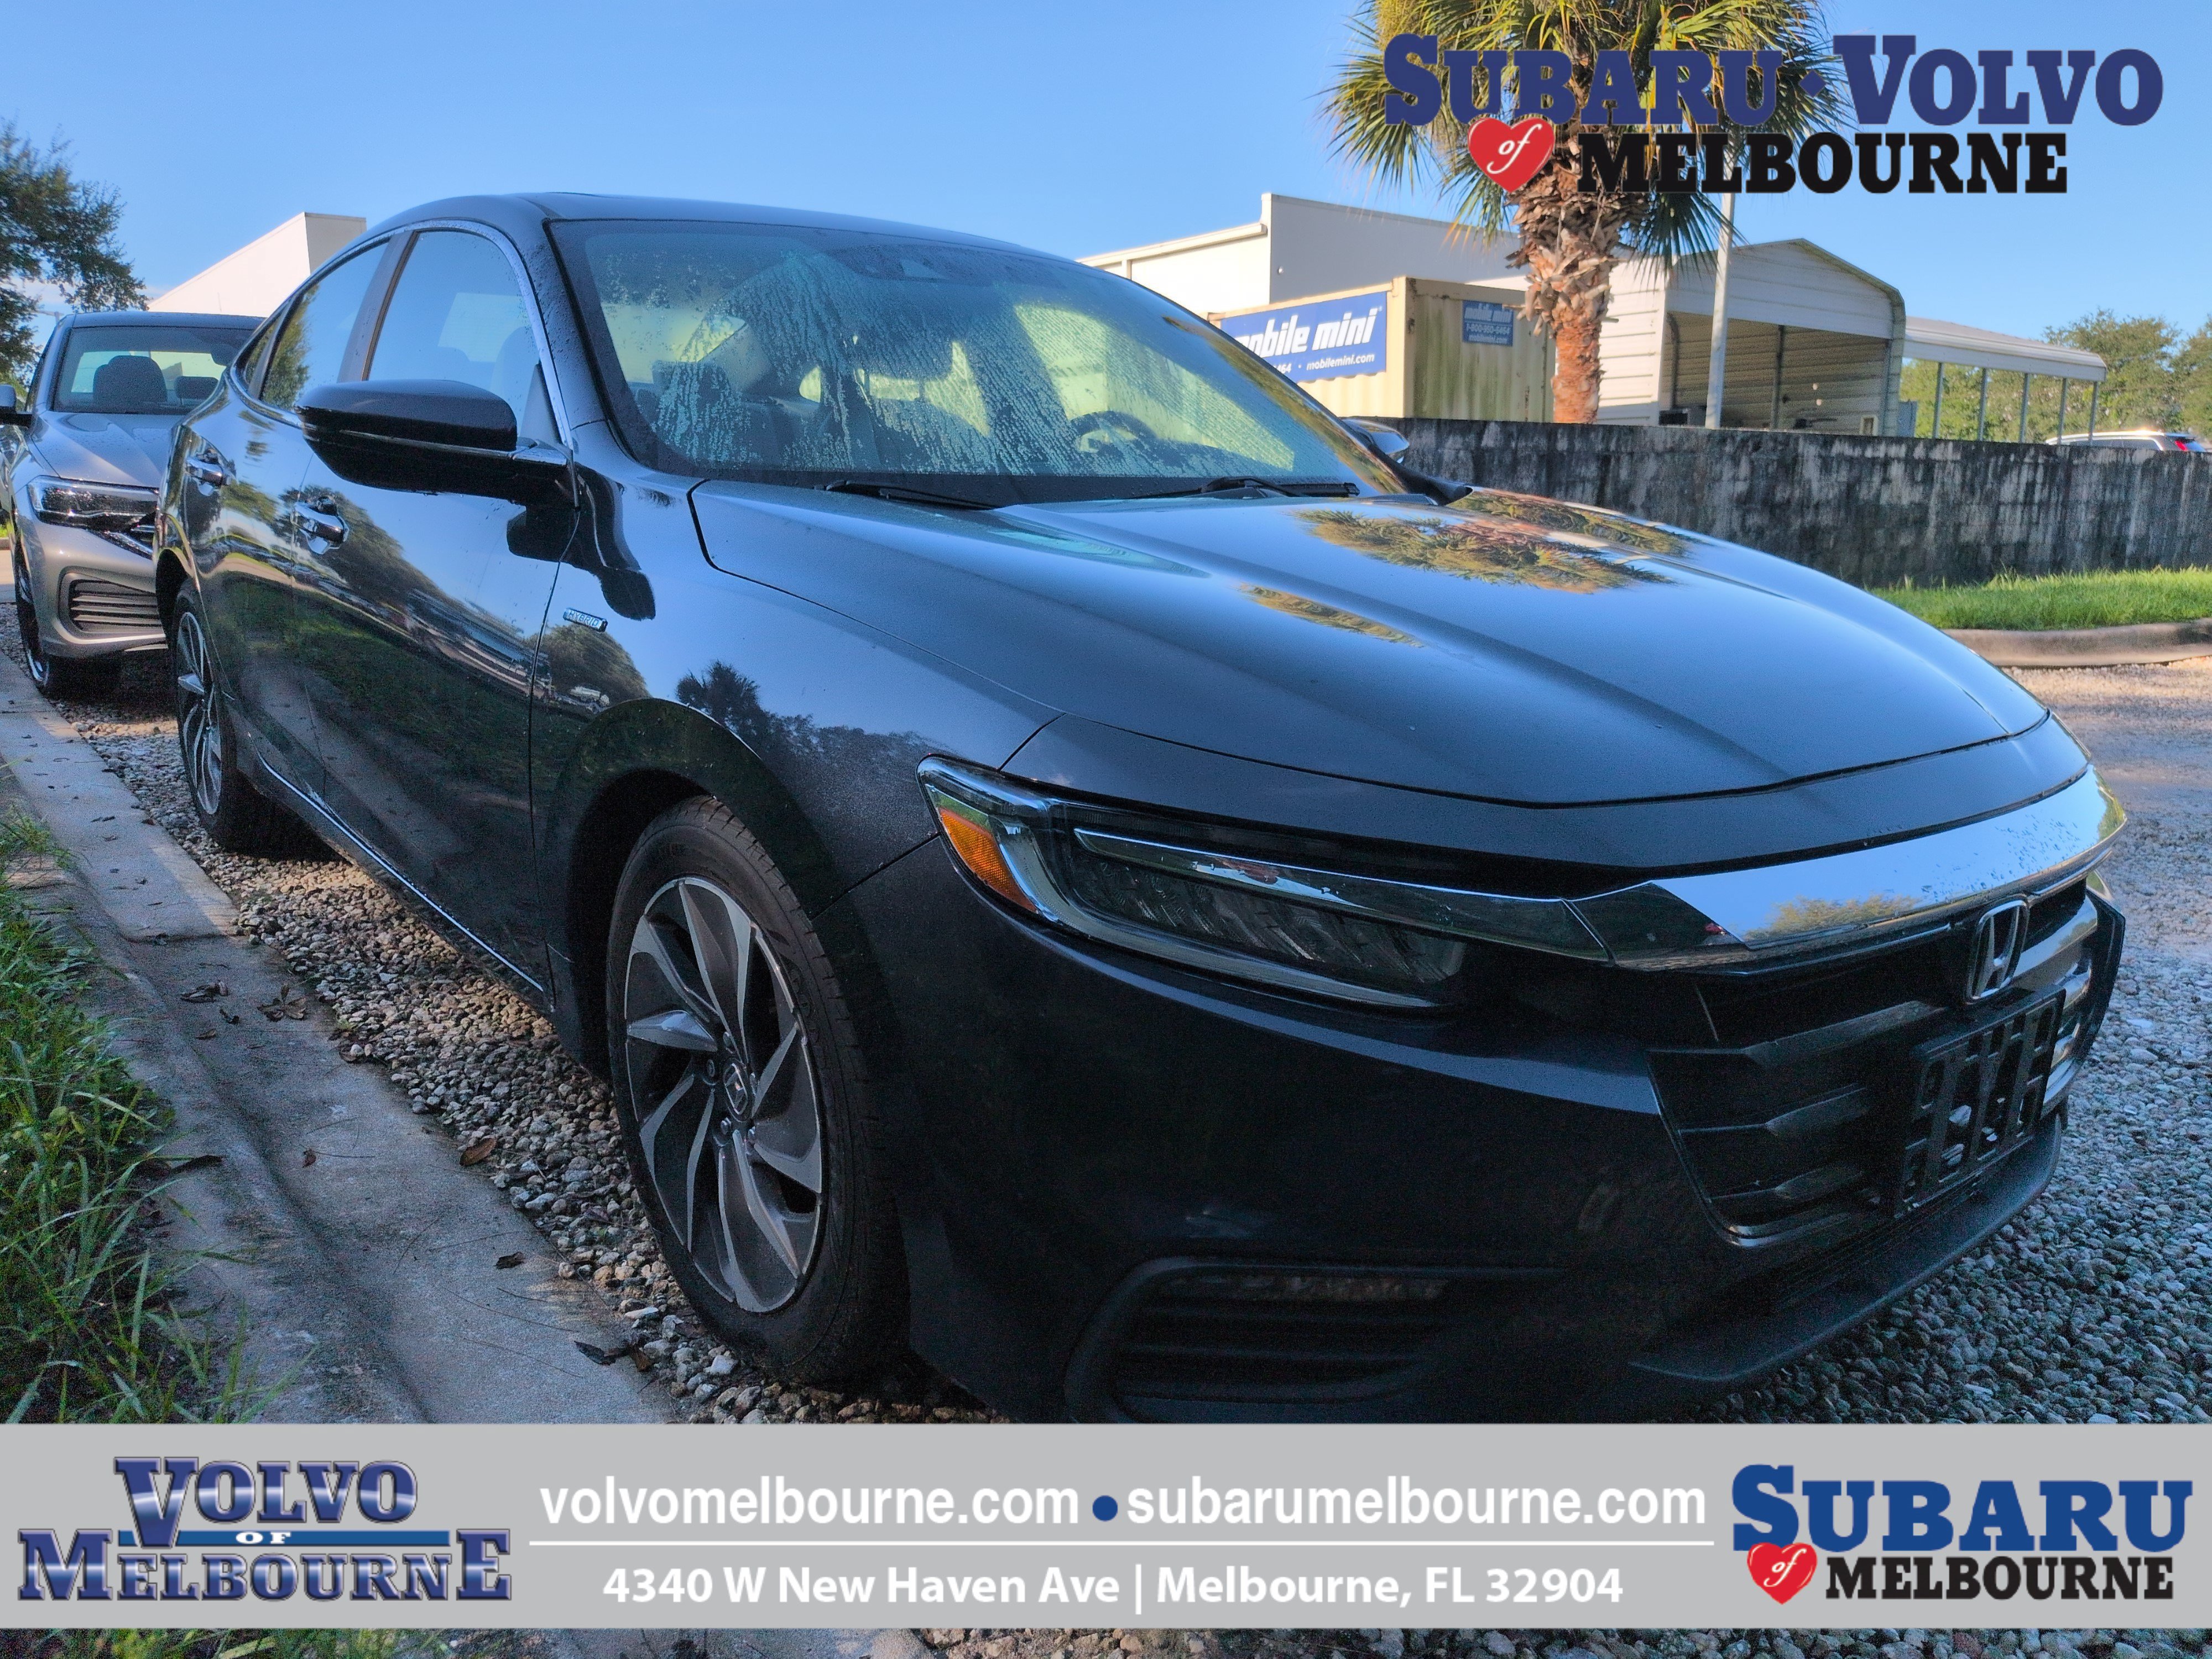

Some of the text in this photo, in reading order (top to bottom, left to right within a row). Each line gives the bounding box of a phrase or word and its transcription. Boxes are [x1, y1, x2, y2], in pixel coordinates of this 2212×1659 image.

[1312, 307, 1378, 351] mini
[1306, 353, 1375, 371] mobilemini.com
[568, 610, 599, 627] HYBRID
